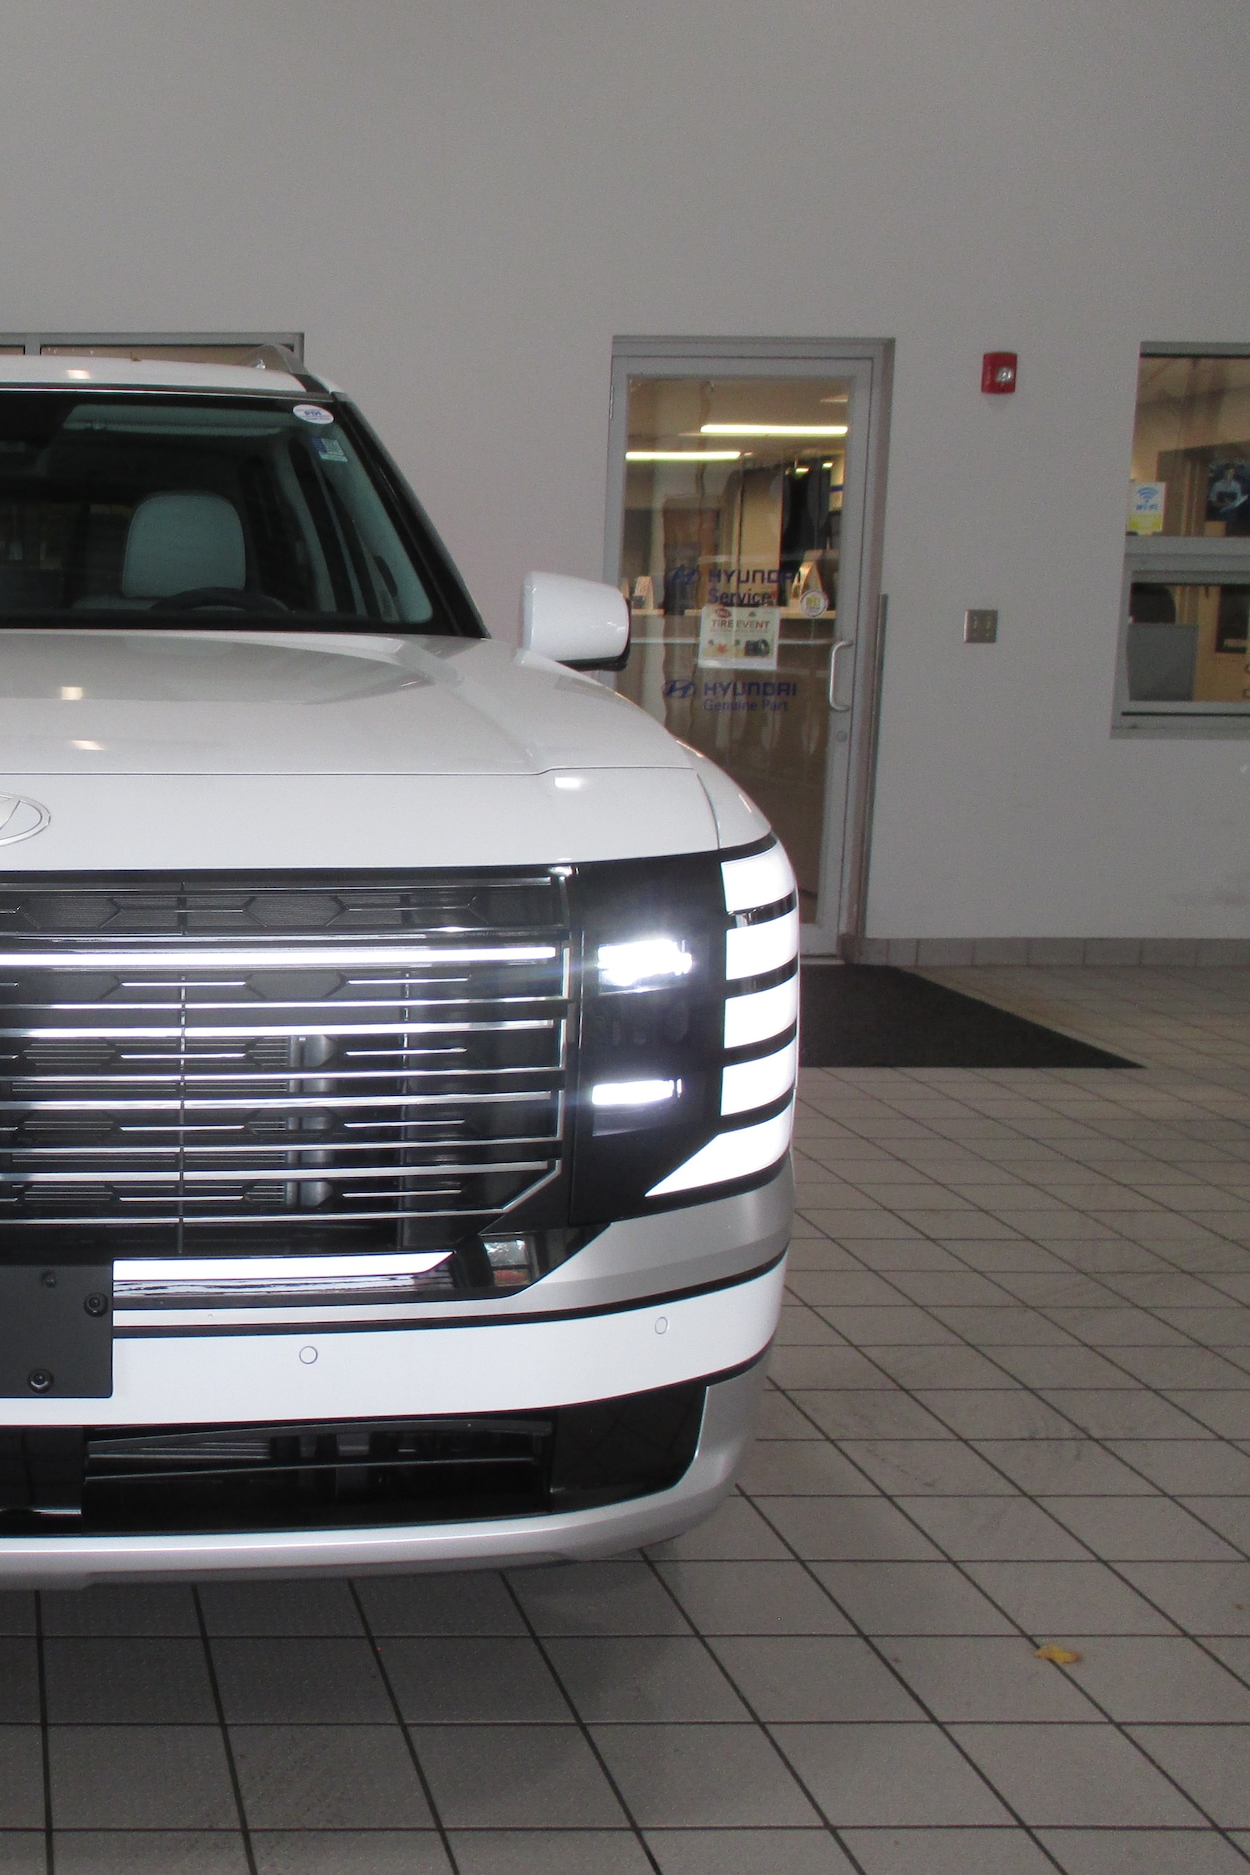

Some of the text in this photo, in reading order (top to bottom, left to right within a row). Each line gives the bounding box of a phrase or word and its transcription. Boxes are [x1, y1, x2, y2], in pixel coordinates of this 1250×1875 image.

[708, 568, 802, 584] HYUNDAI
[708, 588, 772, 605] Service
[711, 619, 770, 629] TIRE EVENT
[703, 681, 798, 697] HYUNDAI
[703, 698, 758, 712] Genuine
